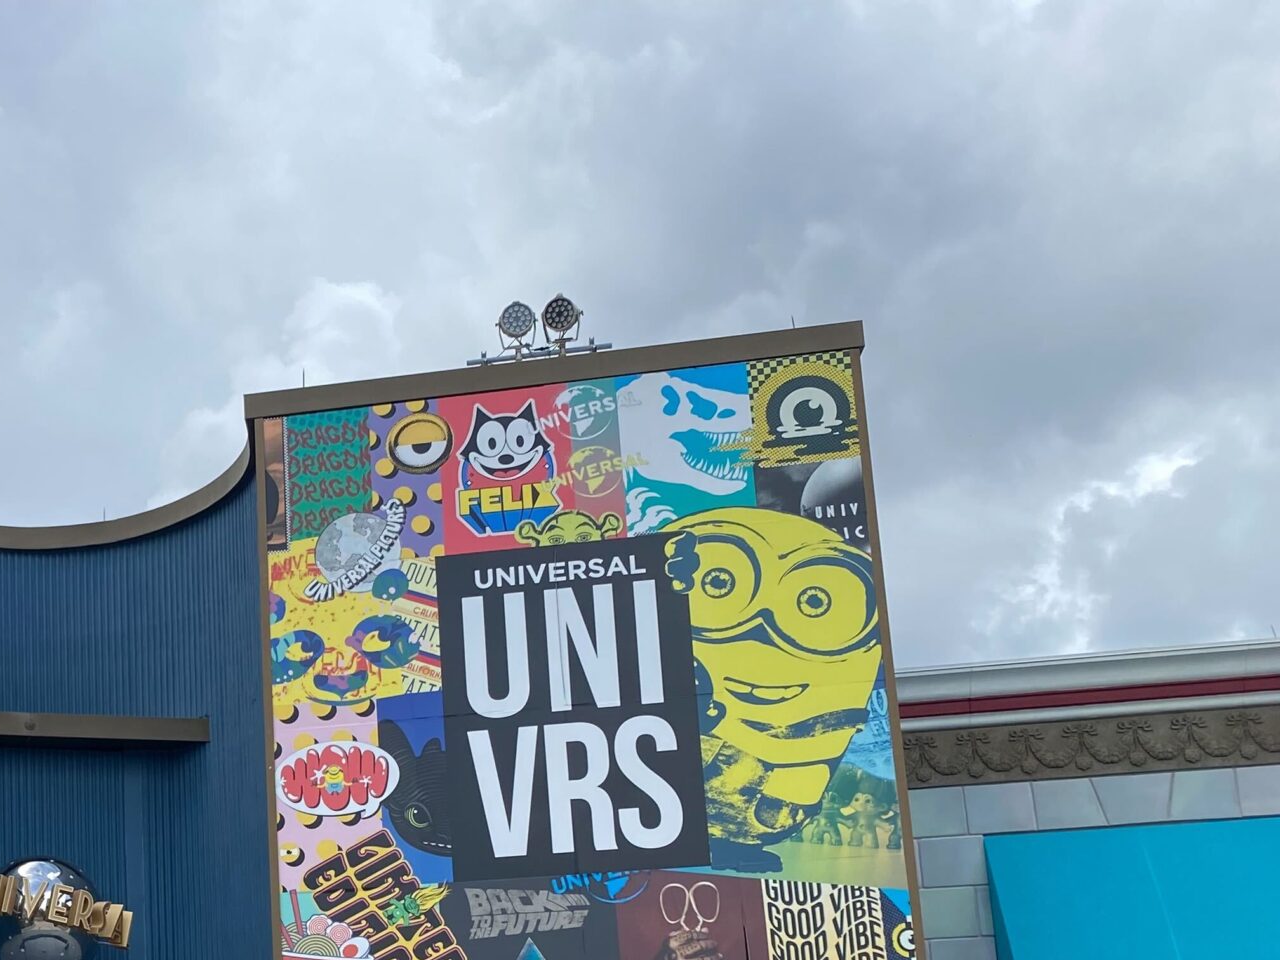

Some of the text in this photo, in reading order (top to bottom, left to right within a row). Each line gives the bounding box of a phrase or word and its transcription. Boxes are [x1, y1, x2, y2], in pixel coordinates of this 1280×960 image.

[459, 484, 559, 522] FELIX
[815, 502, 858, 519] UNIV
[303, 550, 382, 604] UNIVERSAL
[474, 554, 647, 589] UNIVERSAL
[461, 579, 664, 719] UNI
[281, 745, 388, 811] WOW
[466, 714, 684, 858] VRS
[464, 887, 568, 916] BACK
[491, 909, 589, 937] FUTURE
[768, 902, 825, 939] GOOD
